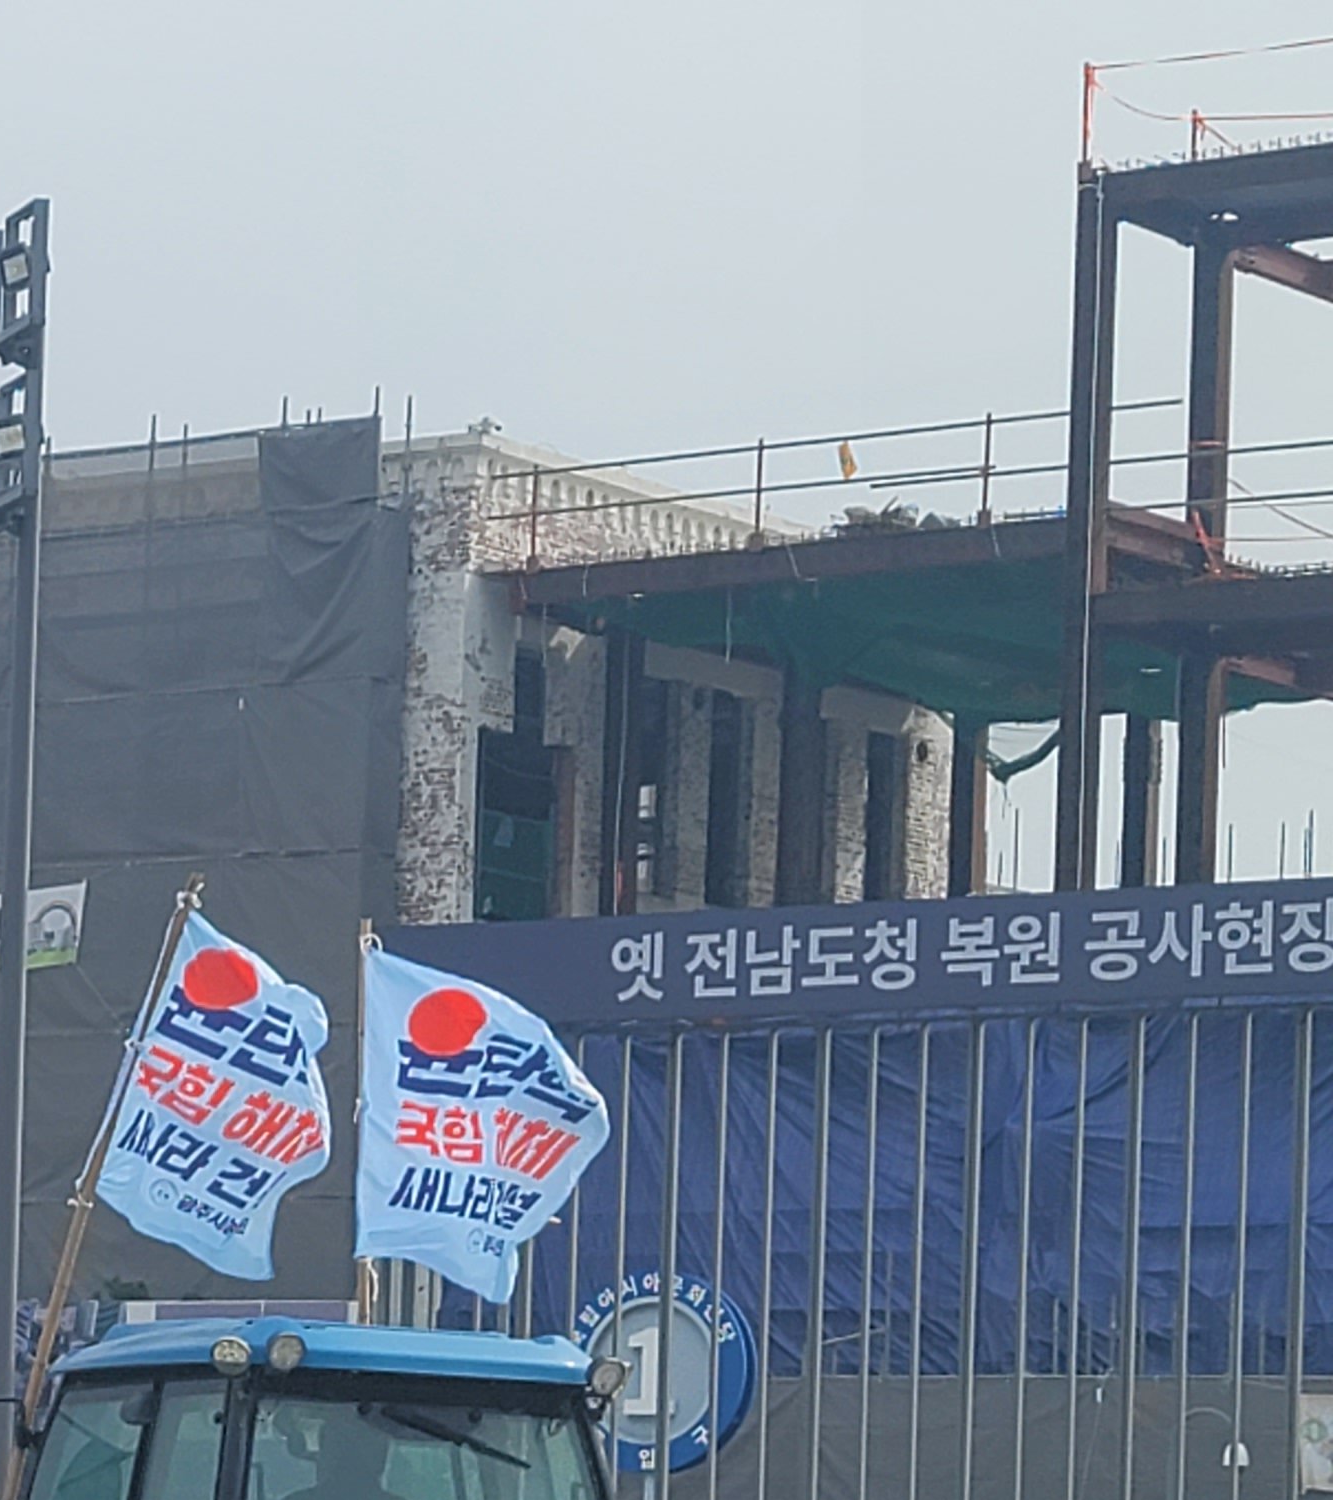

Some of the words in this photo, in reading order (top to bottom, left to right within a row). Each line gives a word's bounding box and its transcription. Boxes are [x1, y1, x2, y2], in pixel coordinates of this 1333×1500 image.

[611, 930, 665, 1002] 옛
[684, 917, 921, 999] 전남도청
[939, 911, 1061, 987] 복원
[1084, 897, 1333, 980] 공사현장
[207, 1158, 287, 1211] 건
